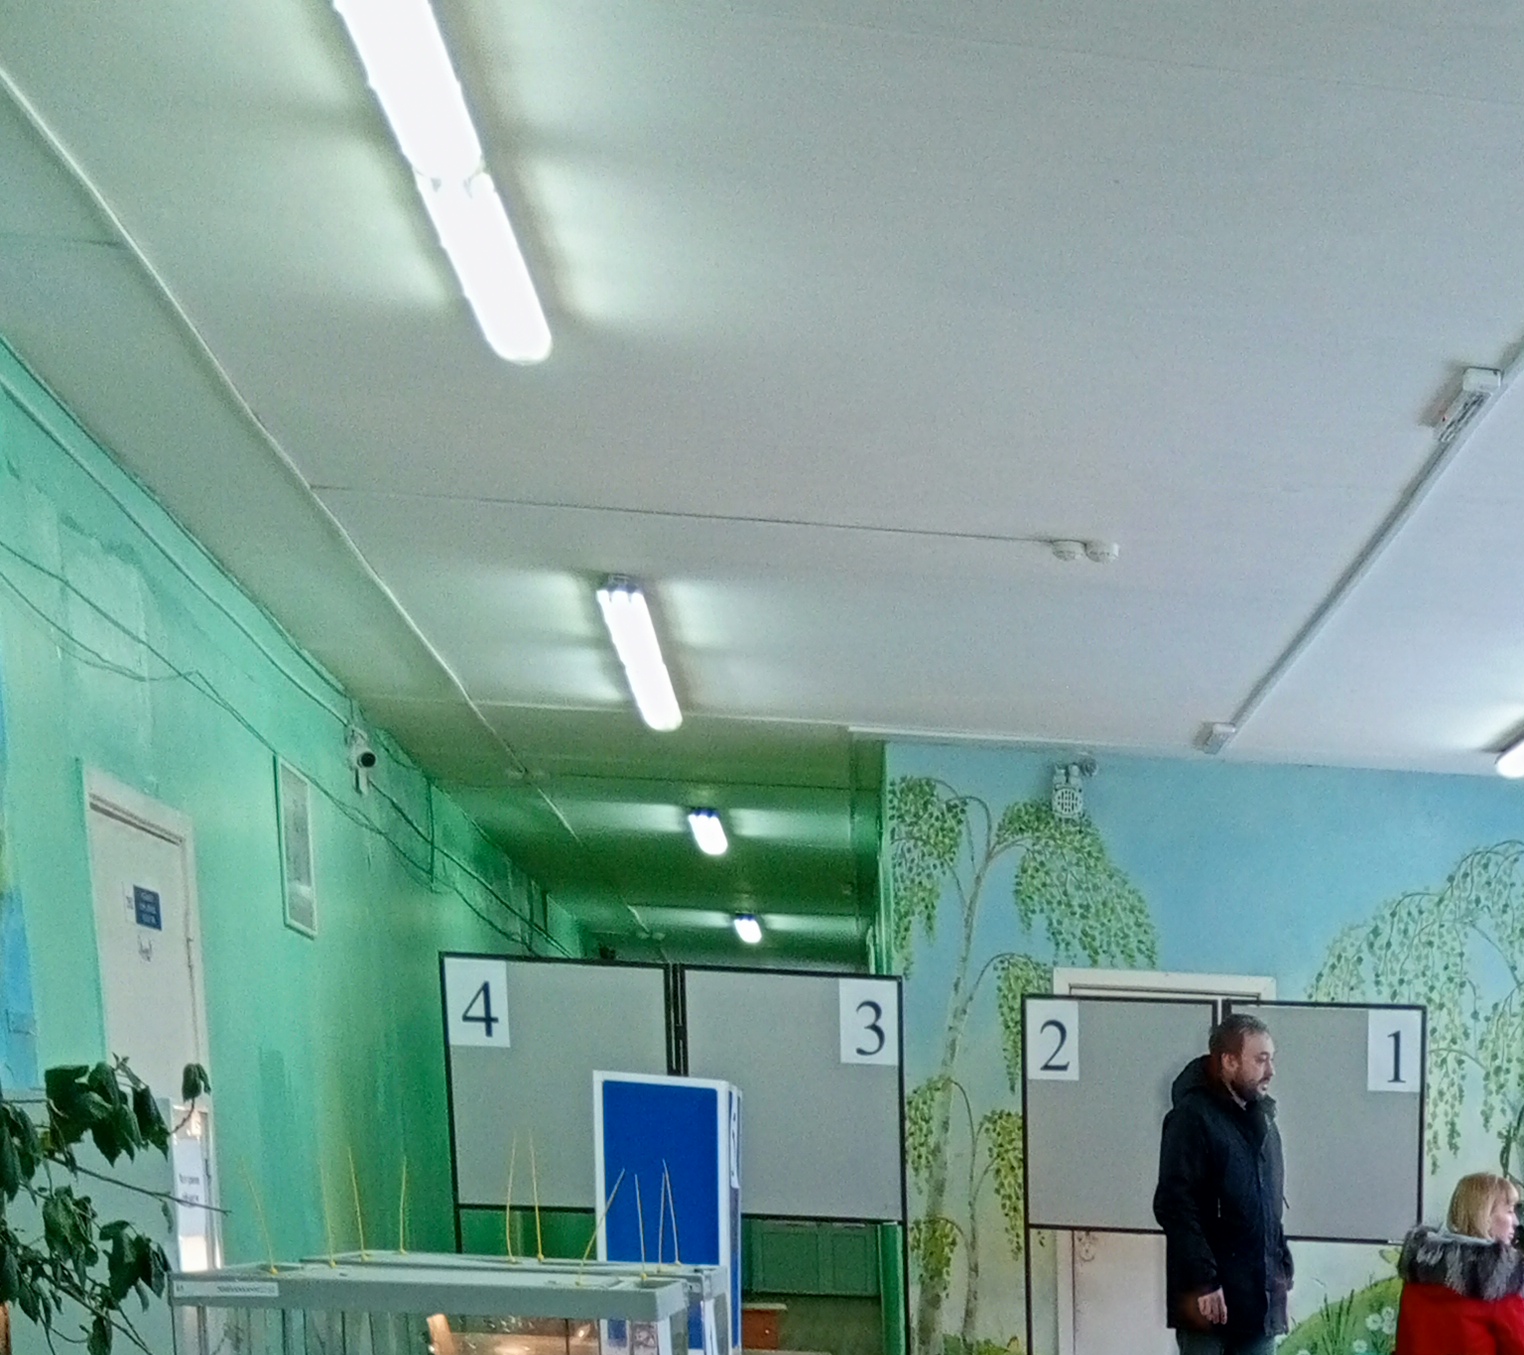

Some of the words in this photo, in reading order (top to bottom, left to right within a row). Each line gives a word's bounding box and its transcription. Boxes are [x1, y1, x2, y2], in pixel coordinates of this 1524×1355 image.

[461, 980, 499, 1038] 4
[855, 1000, 886, 1056] 3
[1039, 1019, 1071, 1072] 2
[1386, 1030, 1407, 1084] 1
